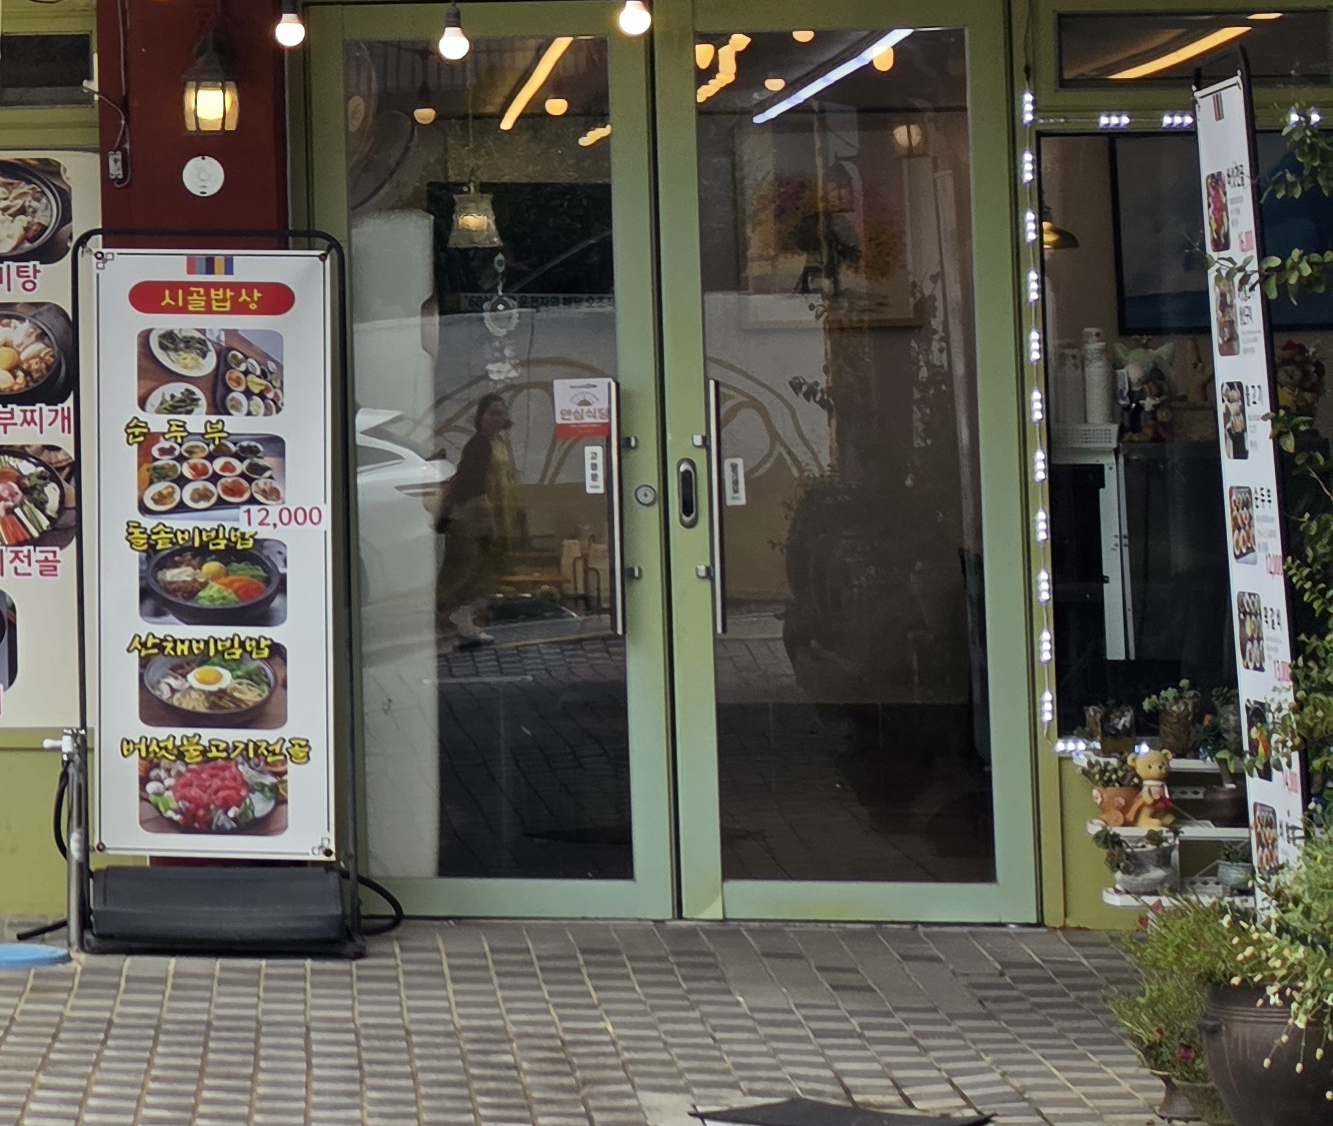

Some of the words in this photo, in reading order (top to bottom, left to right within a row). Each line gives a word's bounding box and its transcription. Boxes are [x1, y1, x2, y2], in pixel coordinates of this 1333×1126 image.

[160, 287, 263, 312] 시골밥상
[125, 417, 229, 445] 순두부
[242, 506, 323, 530] 12,000
[126, 633, 274, 661] 산채비빔밥
[120, 733, 313, 765] 버섯불고기전골
